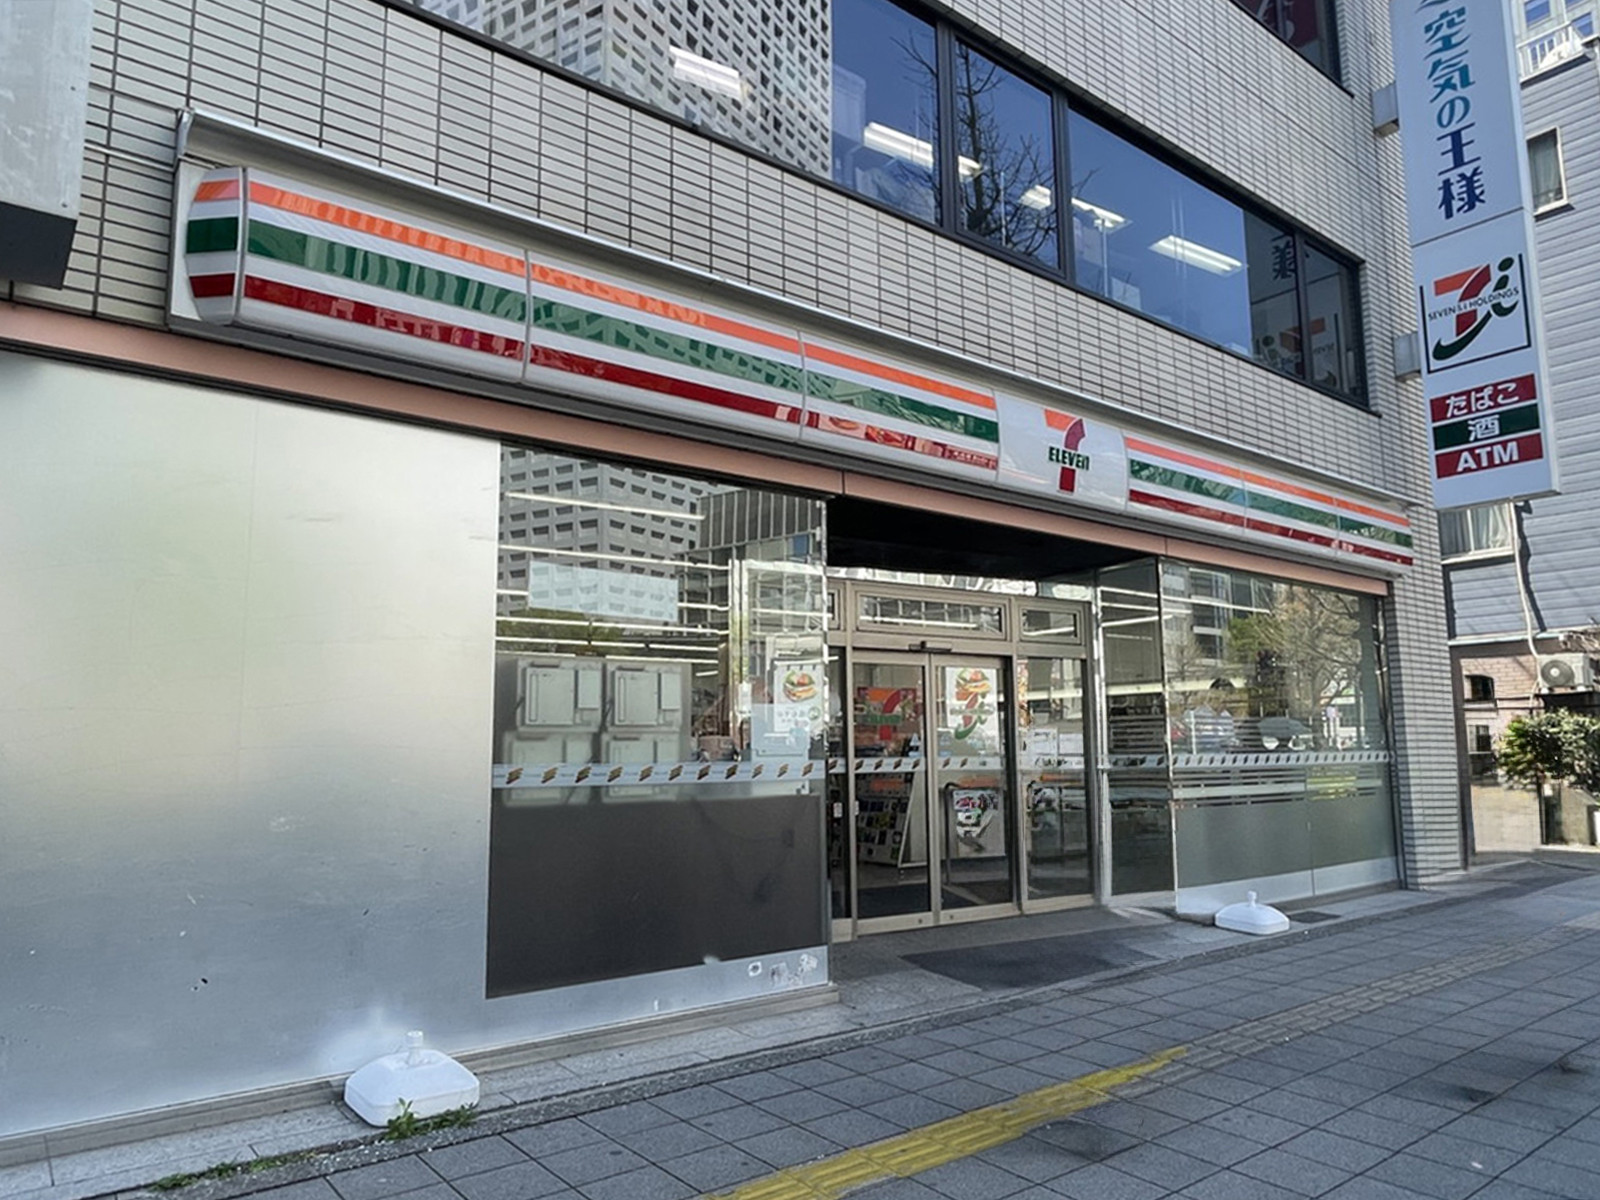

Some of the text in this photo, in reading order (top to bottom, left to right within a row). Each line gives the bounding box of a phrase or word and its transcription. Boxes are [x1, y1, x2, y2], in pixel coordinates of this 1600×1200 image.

[1415, 0, 1486, 220] 空気の王様
[1469, 287, 1519, 308] HOLDINGS
[1445, 382, 1519, 418] たばこ
[1468, 414, 1499, 441] 酒
[1457, 442, 1519, 472] ATM
